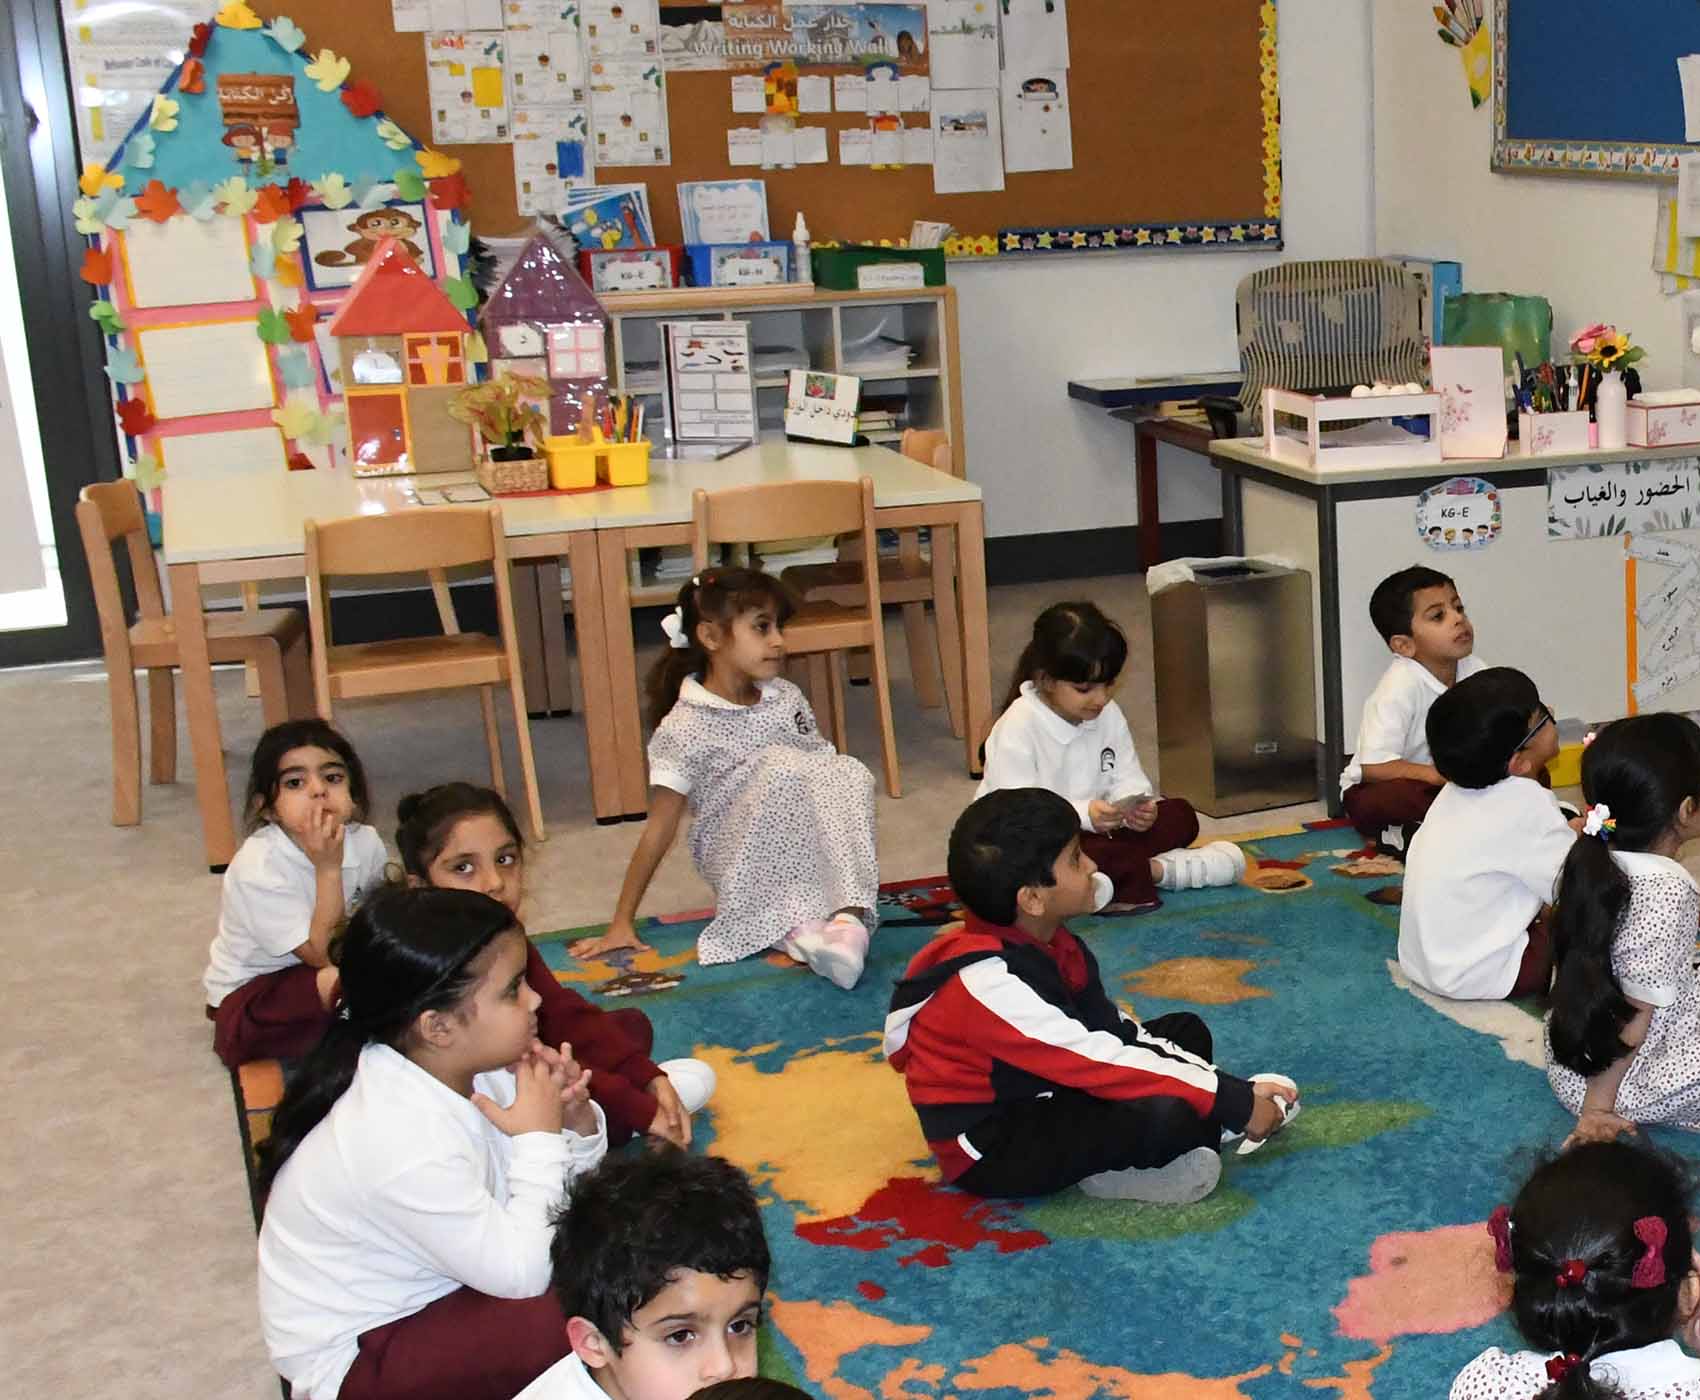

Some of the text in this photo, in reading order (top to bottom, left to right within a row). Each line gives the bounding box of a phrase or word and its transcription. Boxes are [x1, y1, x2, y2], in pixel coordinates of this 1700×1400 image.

[694, 39, 890, 59] Writing Working Wall
[1563, 473, 1691, 509] الحضور والغياب
[1440, 507, 1470, 519] KG-E
